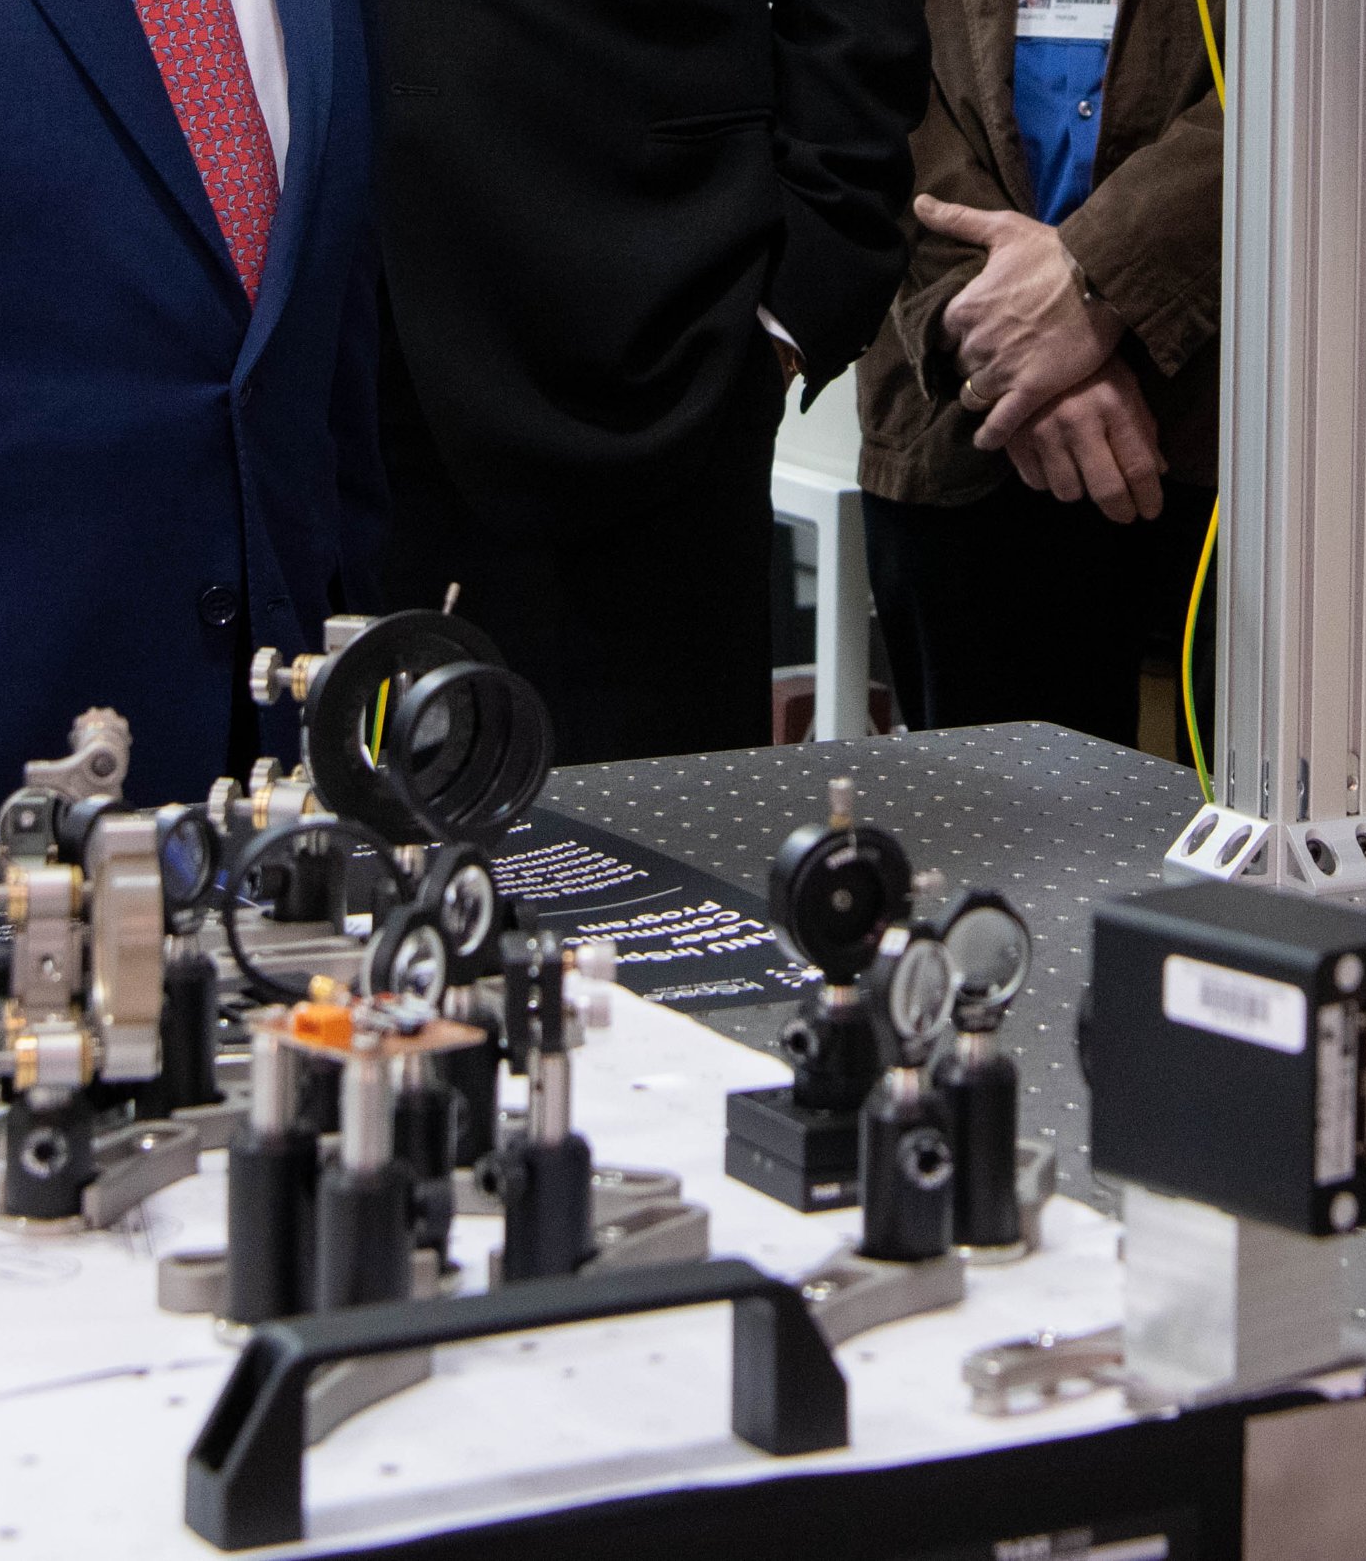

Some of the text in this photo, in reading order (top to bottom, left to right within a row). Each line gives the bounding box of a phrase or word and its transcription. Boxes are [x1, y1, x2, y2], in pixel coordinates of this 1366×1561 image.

[491, 841, 577, 864] network
[520, 853, 604, 876] secured
[546, 858, 617, 879] global,
[562, 871, 649, 894] Leading
[577, 901, 721, 932] Program
[671, 919, 763, 946] Laser
[707, 931, 777, 953] ANU
